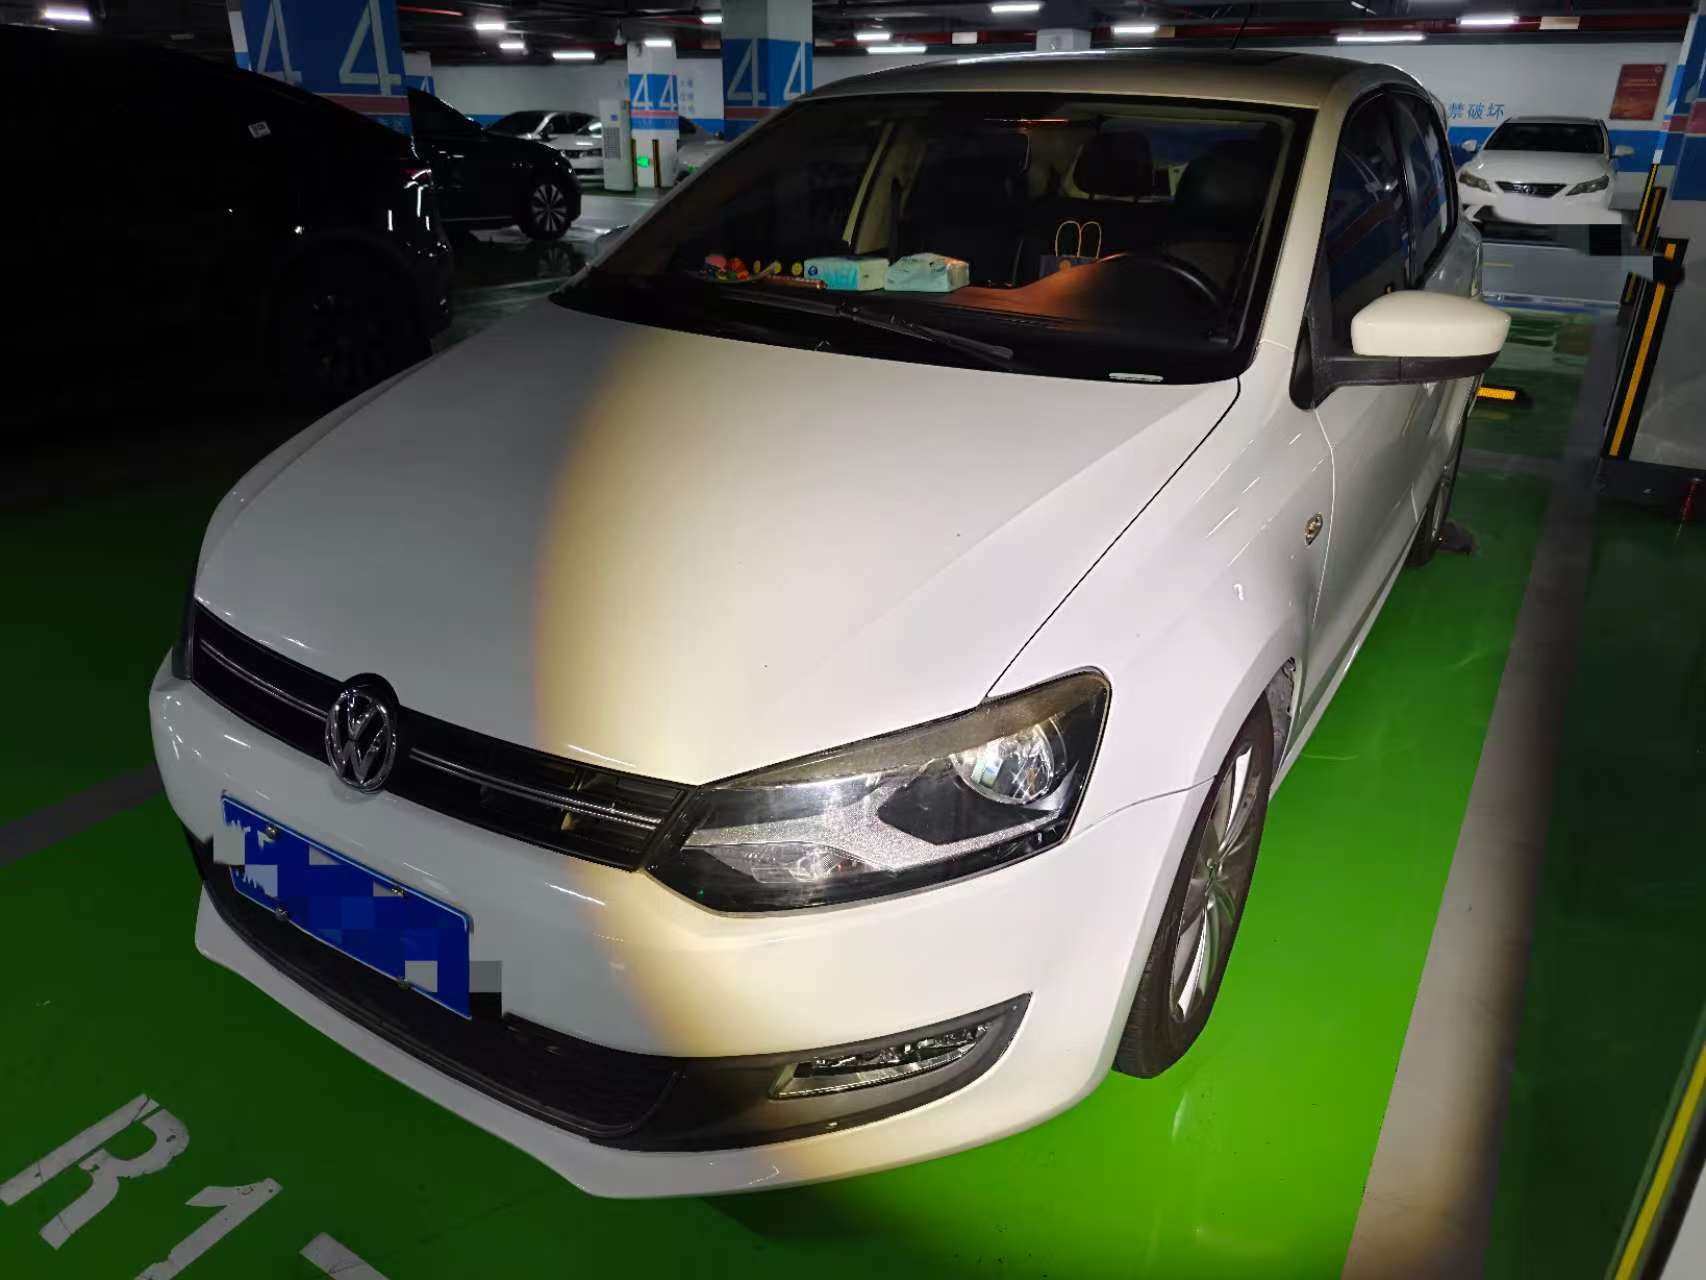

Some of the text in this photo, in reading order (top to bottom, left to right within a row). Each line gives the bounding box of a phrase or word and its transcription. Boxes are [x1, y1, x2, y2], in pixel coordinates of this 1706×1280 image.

[257, 0, 303, 86] 4
[339, 0, 402, 96] 4
[727, 36, 767, 108] 4
[783, 40, 807, 101] 4
[632, 73, 653, 111] 4
[659, 72, 679, 111] 4
